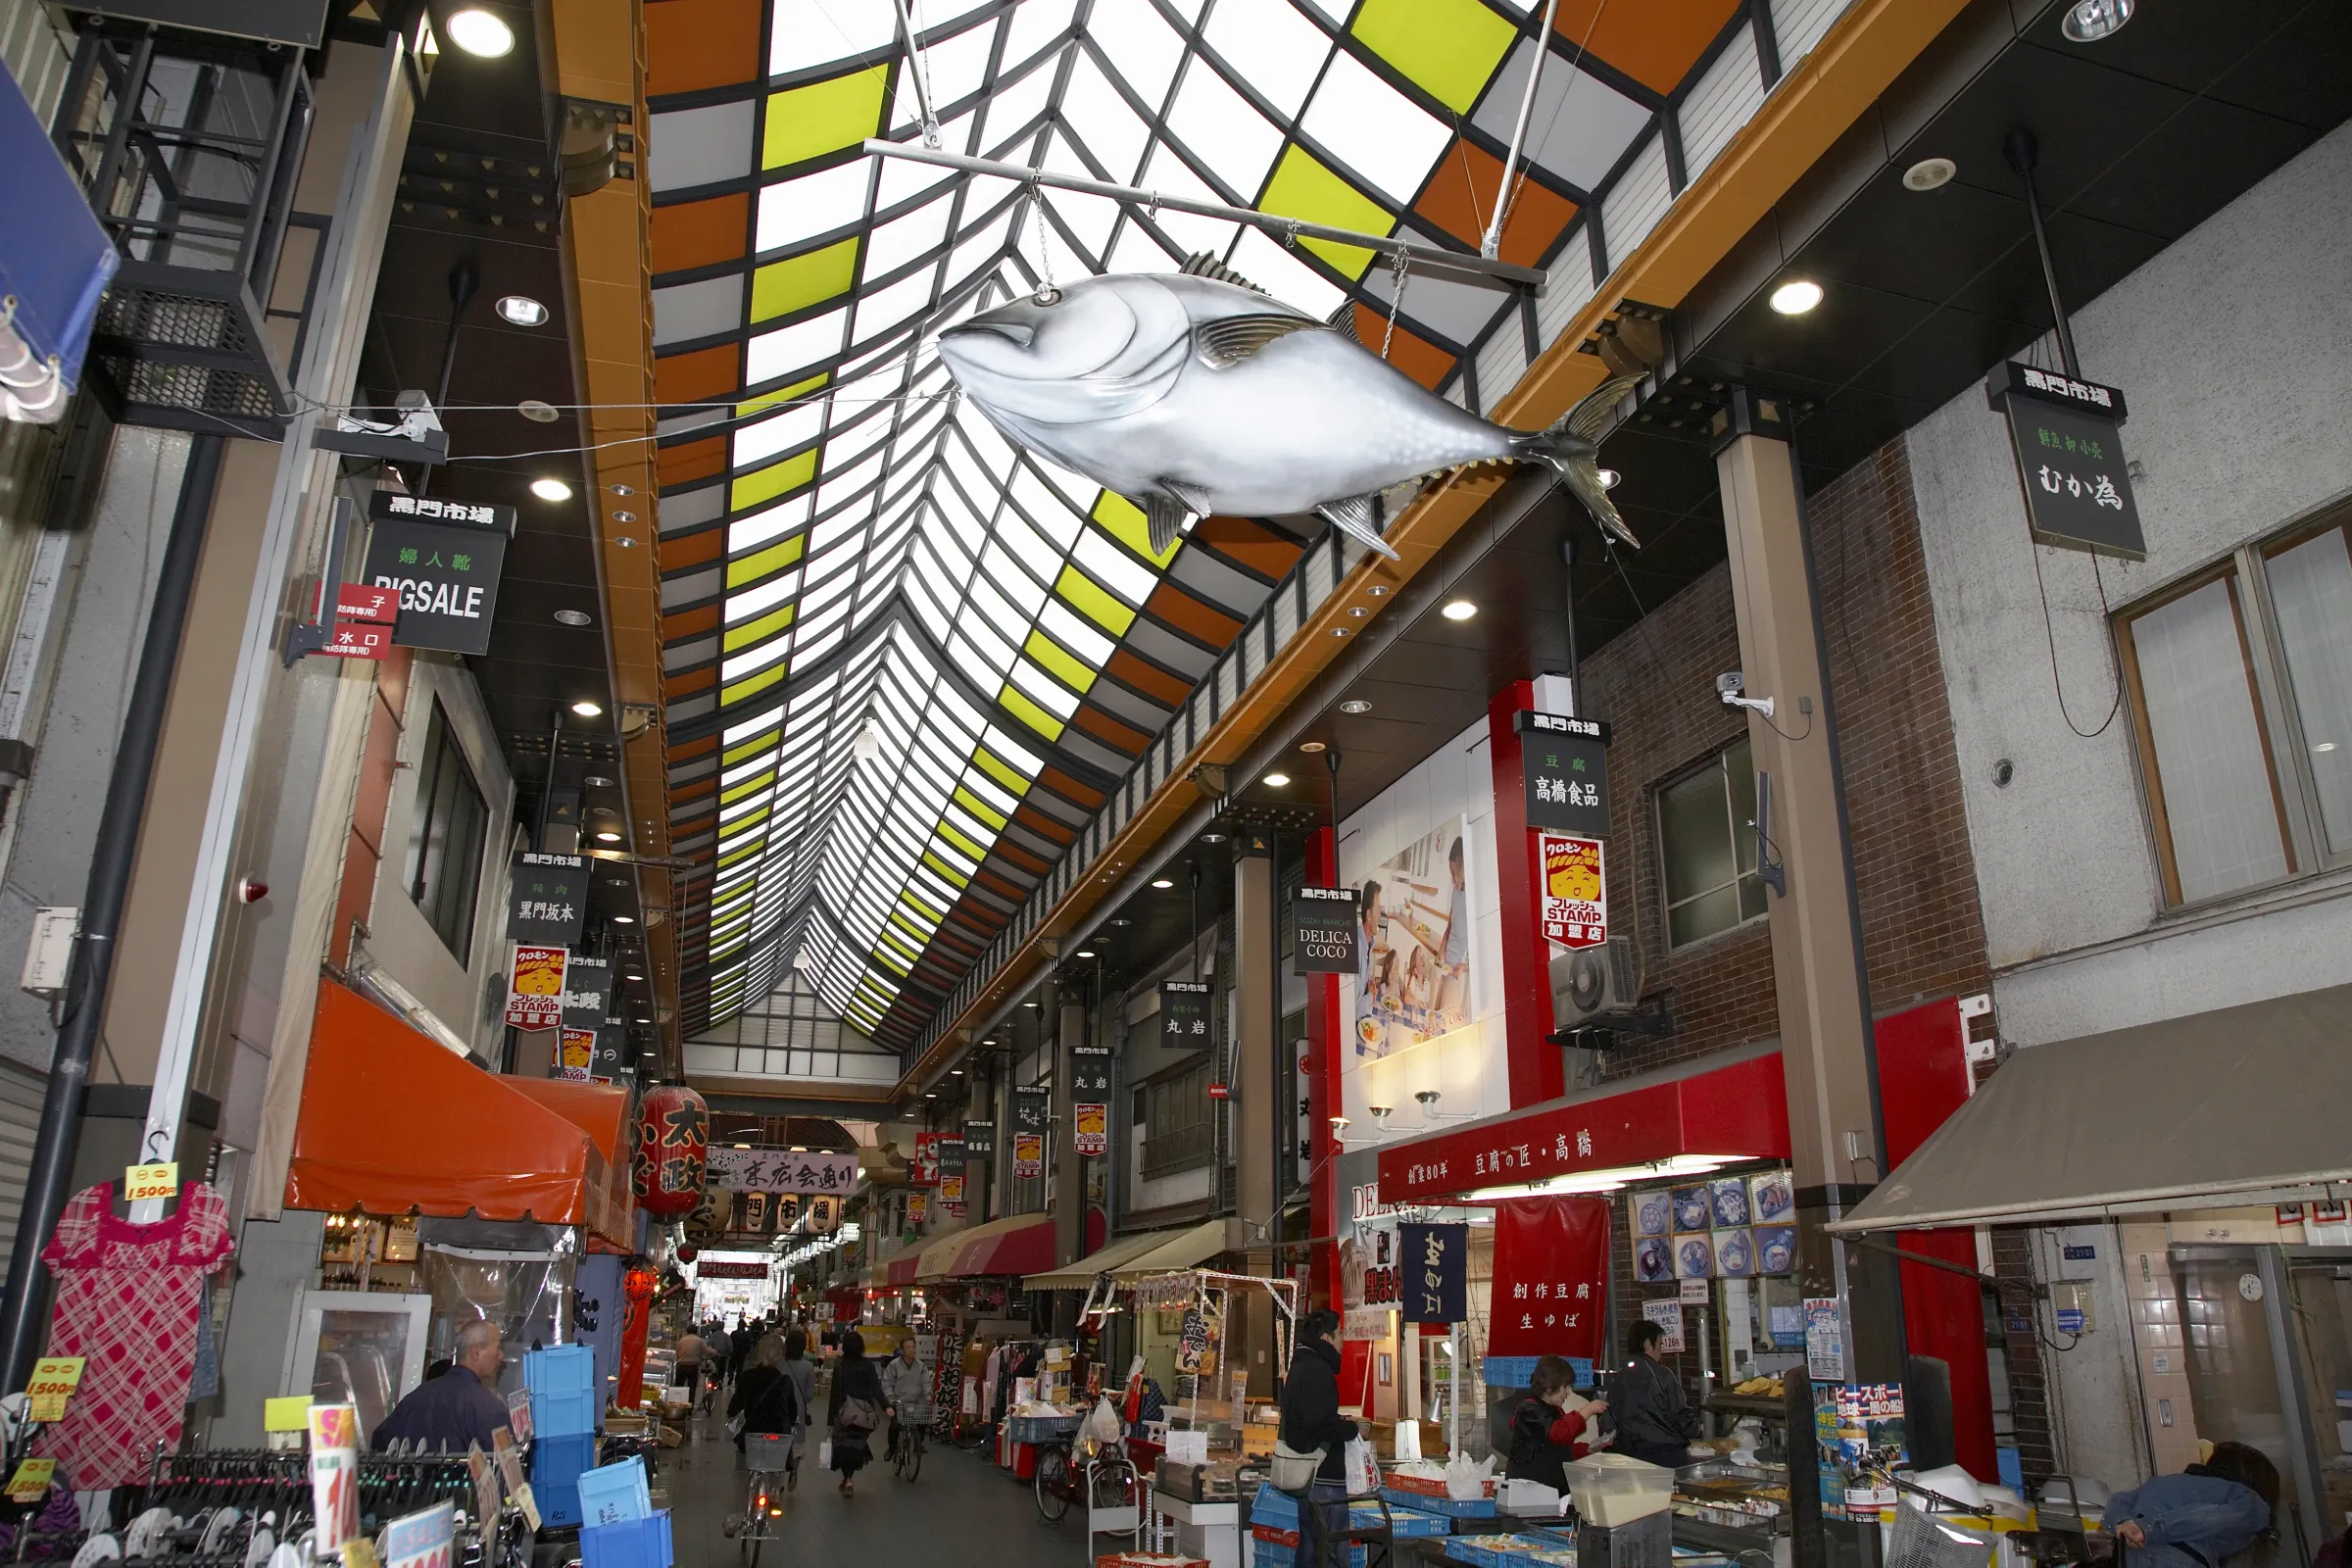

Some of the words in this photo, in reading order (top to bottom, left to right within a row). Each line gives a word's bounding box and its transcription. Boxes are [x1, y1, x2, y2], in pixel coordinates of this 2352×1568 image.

[2023, 368, 2112, 408] 黒門市場
[2037, 465, 2123, 511] むか為
[389, 496, 494, 524] 黒門市場
[398, 547, 471, 571] 婦人靴
[1533, 714, 1600, 736] 黒門市場
[1545, 755, 1586, 772] 豆腐
[1535, 775, 1599, 807] 高橋食品
[1545, 842, 1582, 856] クロモン
[522, 853, 582, 867] 黒門市場
[1300, 888, 1352, 901] 黒門市場
[517, 901, 574, 923] 黒門坂本
[1551, 898, 1596, 912] フレッシュ
[1547, 907, 1602, 924] STAMP
[1299, 929, 1352, 945] DELICA
[1547, 922, 1602, 941] 加盟店
[517, 951, 550, 961] クロモン
[1306, 945, 1347, 958] COCO
[1166, 982, 1207, 993] 黒門市場
[510, 1001, 560, 1012] STAMP
[514, 995, 555, 1004] フレッシュ
[509, 1011, 559, 1025] 加盟店
[1166, 1019, 1206, 1035] 丸岩
[1074, 1047, 1108, 1055] 黒門市場
[1074, 1076, 1107, 1089] 丸岩
[128, 1186, 175, 1200] 1500円
[1513, 1282, 1590, 1299] 創作豆腐
[1520, 1313, 1580, 1329] 生ゆば
[1182, 1314, 1210, 1370] おでん
[26, 1381, 76, 1396] 1500円
